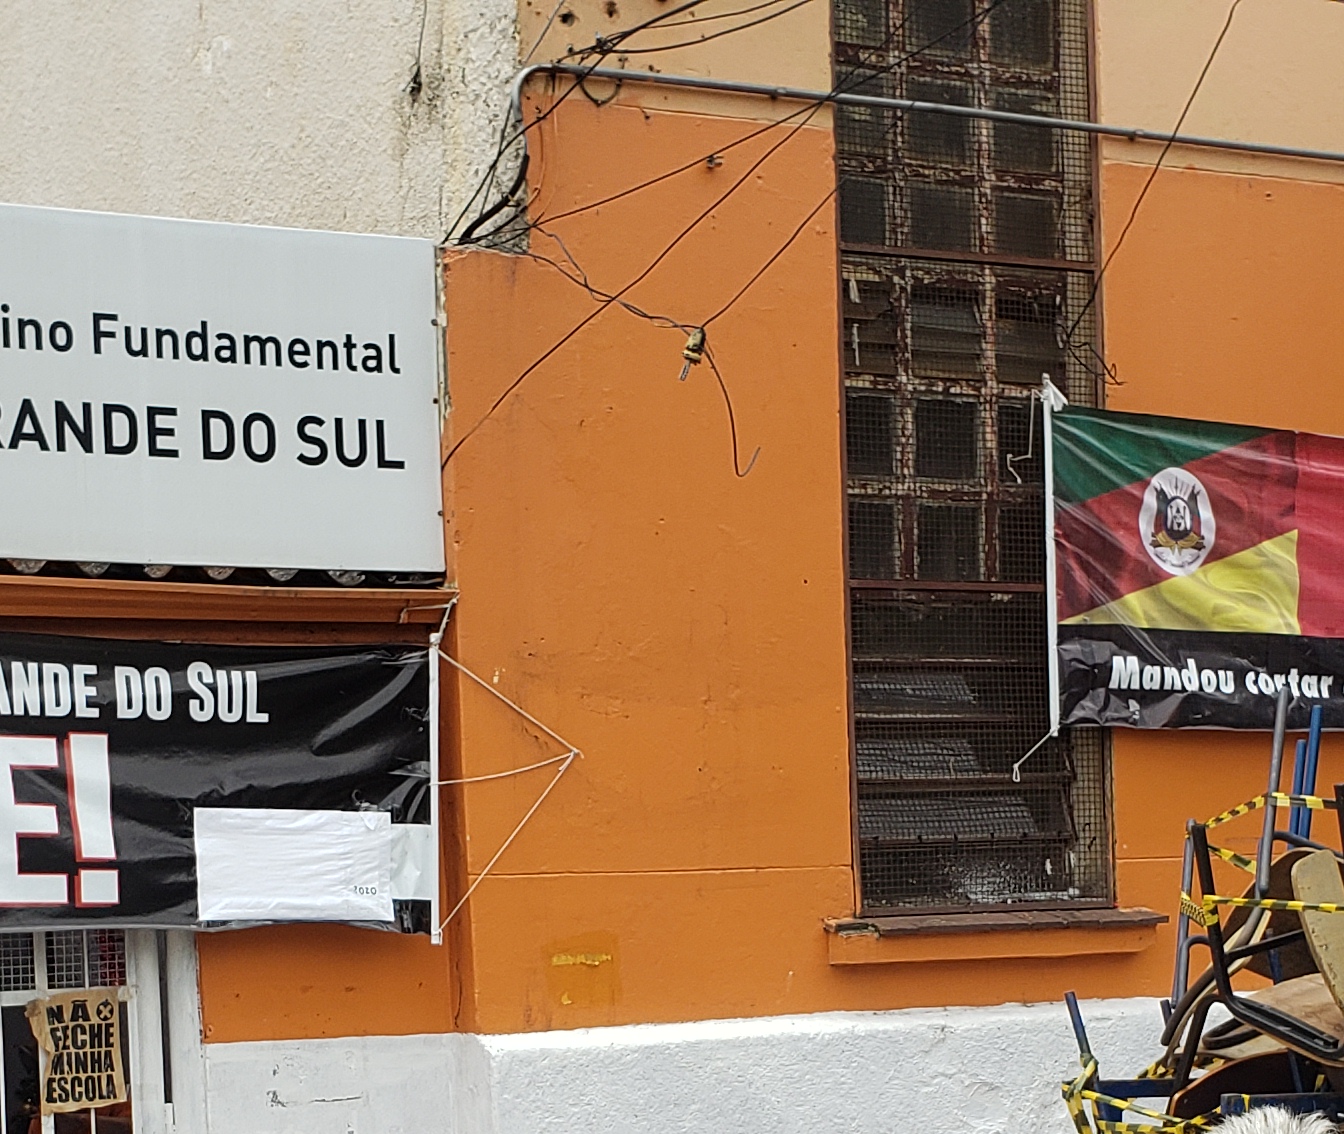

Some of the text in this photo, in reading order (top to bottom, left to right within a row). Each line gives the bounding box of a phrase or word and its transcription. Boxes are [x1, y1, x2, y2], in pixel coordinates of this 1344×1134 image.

[92, 312, 401, 375] Fundamental
[201, 408, 277, 464] DO
[296, 414, 406, 470] SUL
[115, 666, 172, 721] DO
[187, 661, 269, 724] SUL
[1108, 655, 1234, 694] Mandou
[1245, 668, 1333, 701] cortar
[46, 998, 115, 1026] NÃO
[50, 1023, 115, 1051] FECHE
[50, 1051, 115, 1076] MINHA
[46, 1074, 118, 1104] ESCOLA
